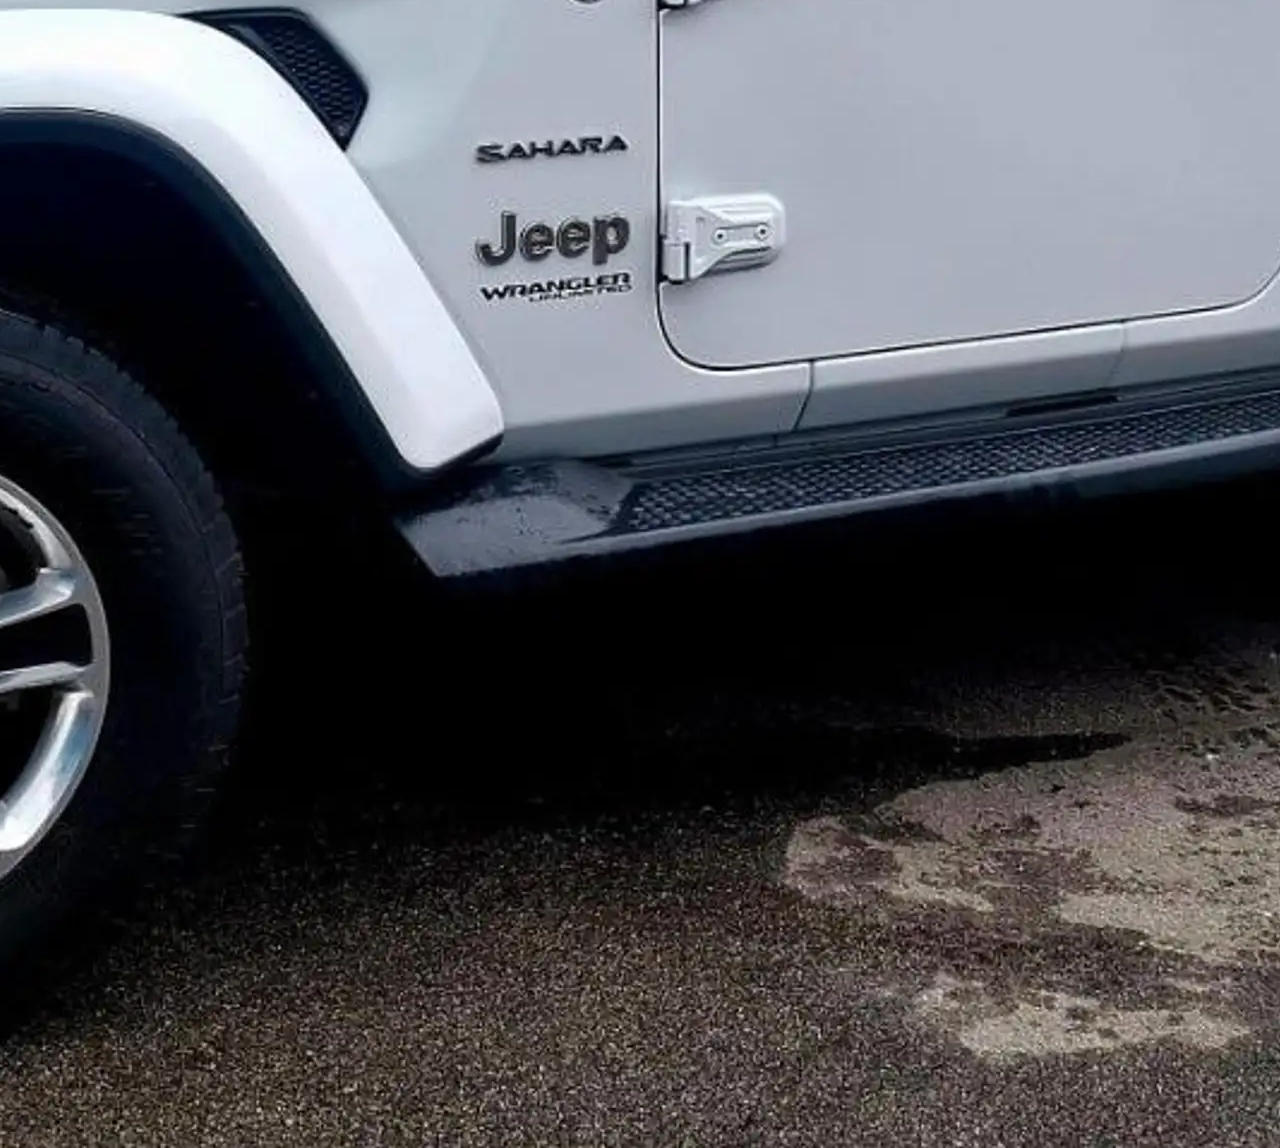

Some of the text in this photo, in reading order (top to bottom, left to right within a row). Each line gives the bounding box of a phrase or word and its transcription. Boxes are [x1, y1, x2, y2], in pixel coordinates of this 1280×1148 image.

[476, 135, 628, 163] SAHARA
[475, 210, 630, 267] Jeep
[480, 272, 631, 301] WRANGLER
